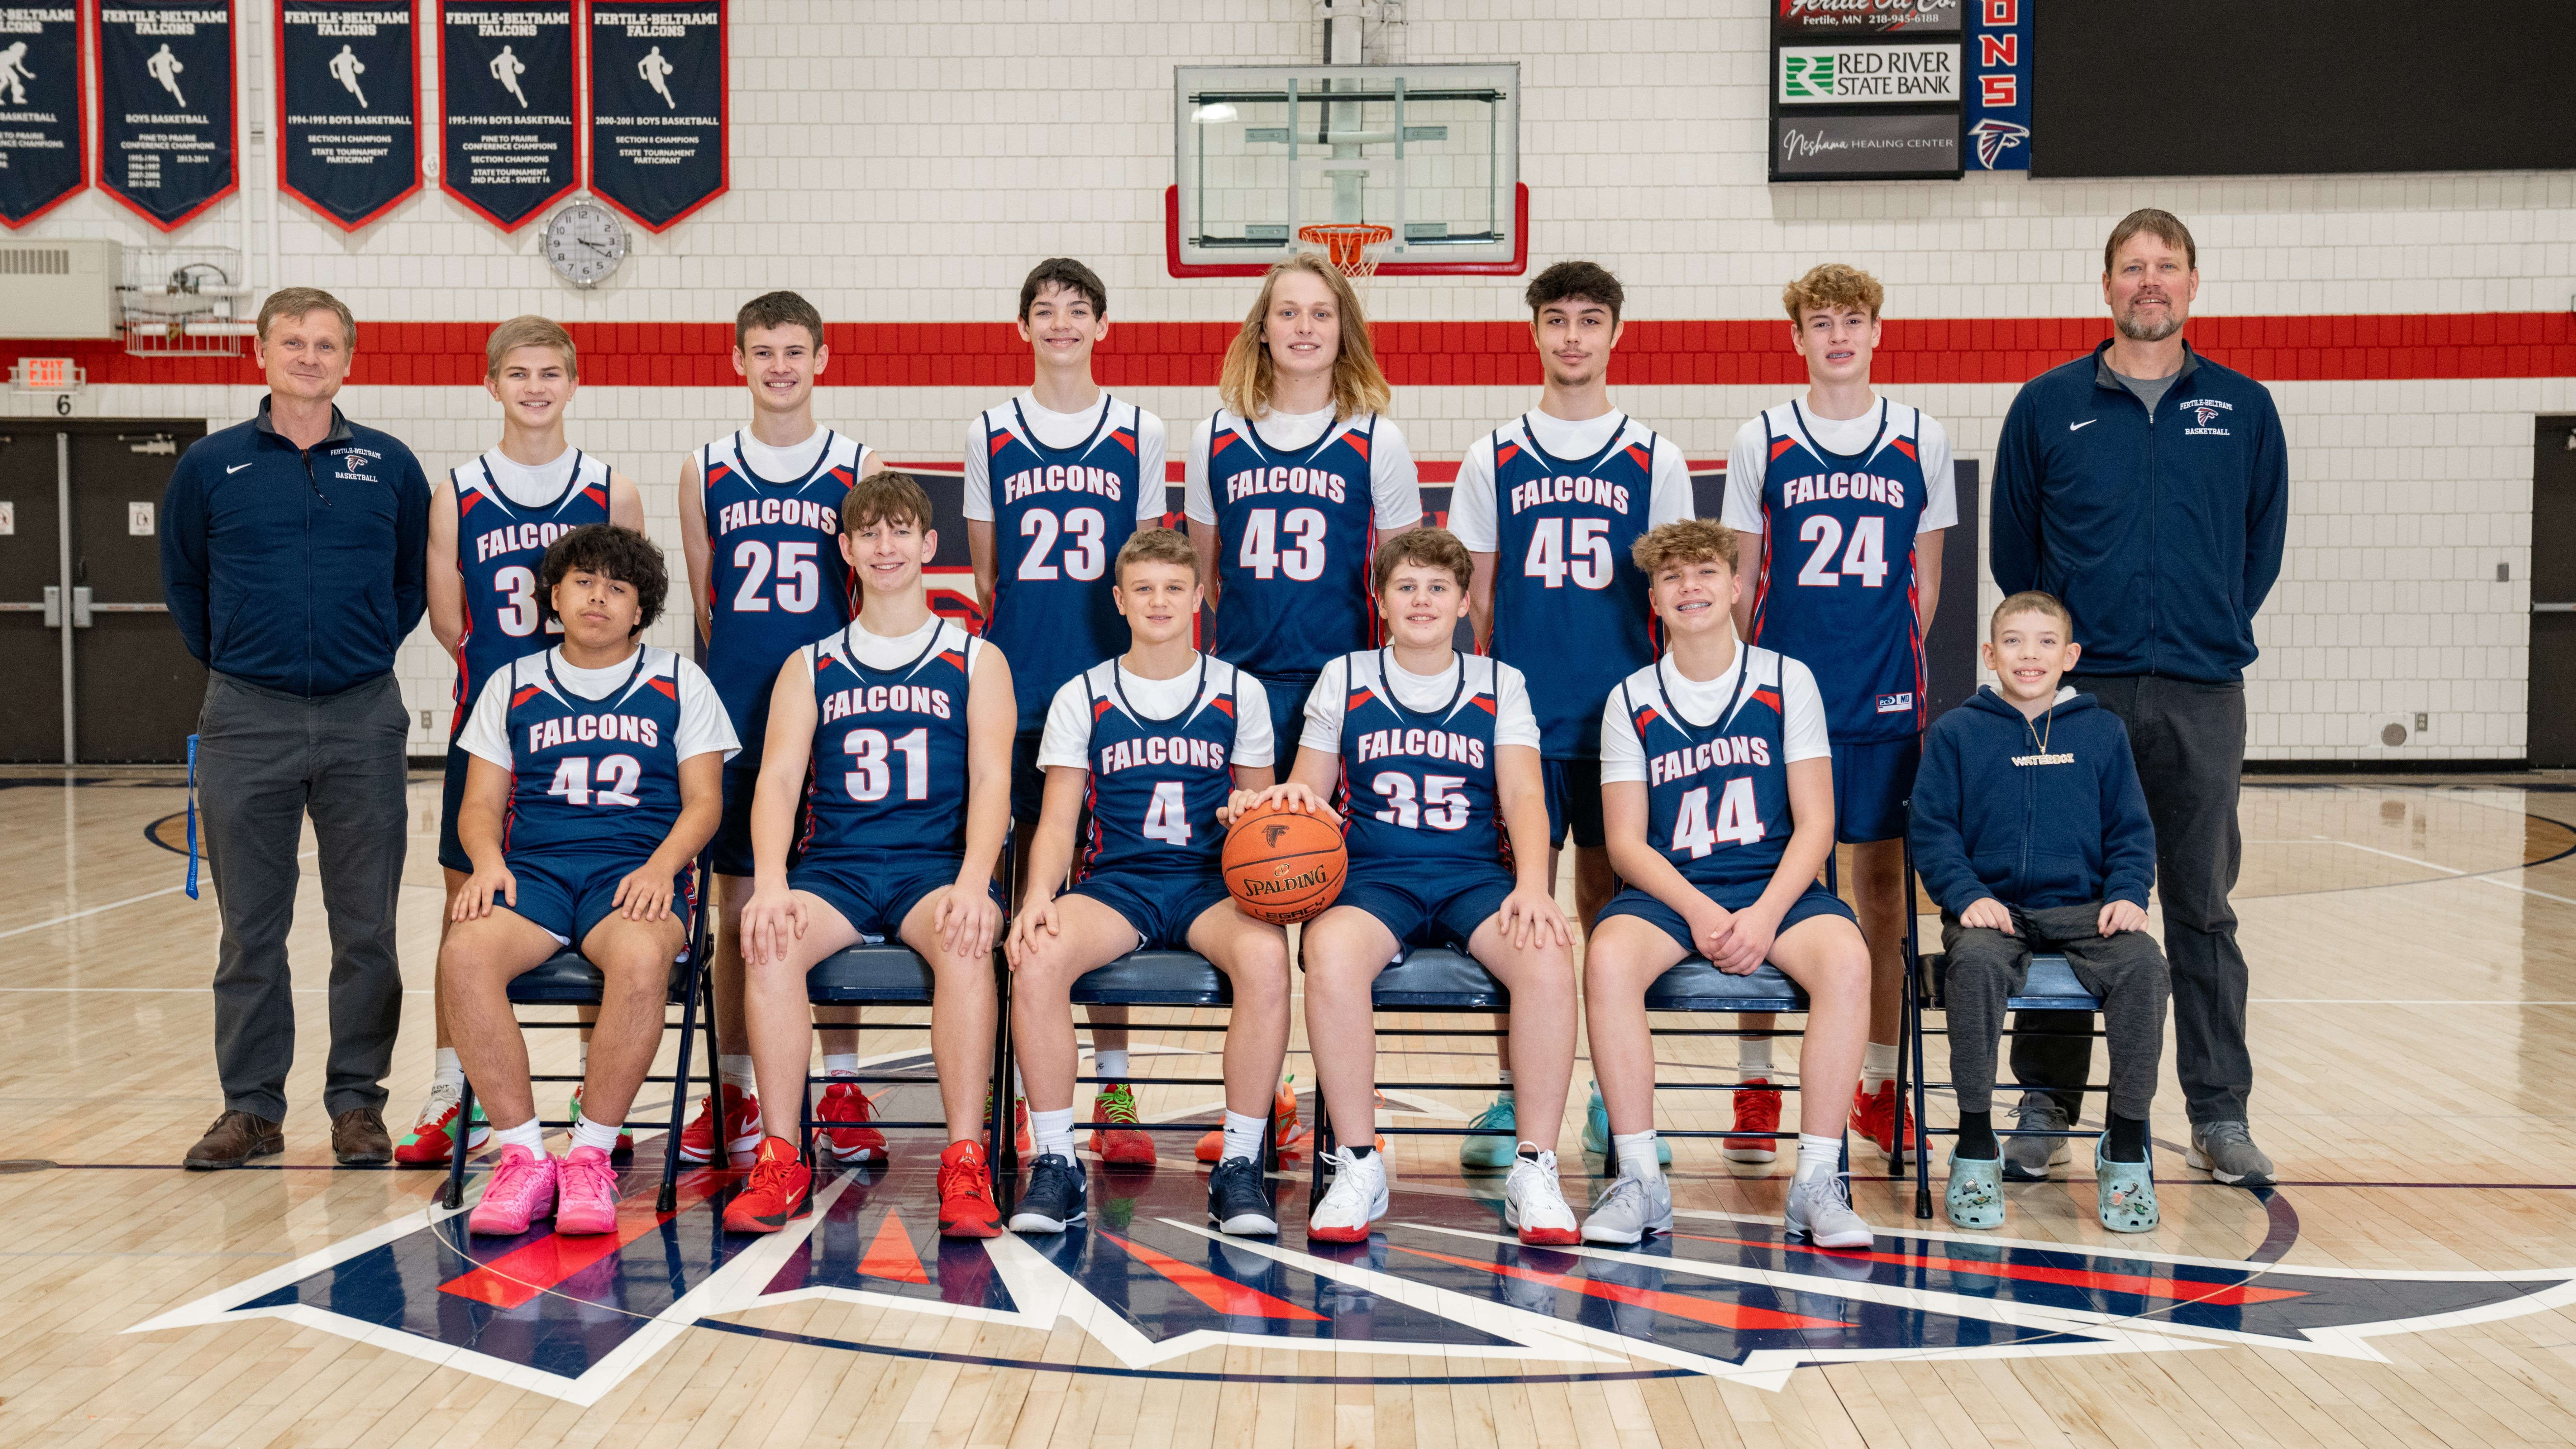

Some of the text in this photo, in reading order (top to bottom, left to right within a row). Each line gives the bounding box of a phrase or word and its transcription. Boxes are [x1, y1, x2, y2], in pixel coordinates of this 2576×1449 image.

[102, 10, 227, 23] FERTILE-BELTRAMI
[285, 11, 409, 24] FERTILE-BELTRAMI
[445, 12, 569, 24] FERTILE-BELTRAMI
[594, 13, 717, 25] FERTILE-BELTRAMI
[1803, 14, 1939, 26] Fertile, MN 218-945-6188
[135, 23, 195, 35] FALCONS
[318, 24, 377, 36] FALCONS
[479, 25, 537, 36] FALCONS
[626, 25, 685, 37] FALCONS
[1839, 52, 1951, 74] RED RIVER
[1838, 75, 1951, 96] STATE BANK
[125, 114, 209, 124] BOYS BASKETBALL
[288, 115, 412, 125] 1994-1995 BOYS BASKETBALL
[448, 116, 572, 125] 1995-1996 BOYS BASKETBALL
[595, 116, 719, 125] 2000-2001 BOYS BASKETBALL
[120, 141, 170, 149] CONFERENCE
[347, 135, 392, 143] CHAMPIONS
[1783, 129, 1953, 161] Neshama HEALING CENTER
[578, 211, 587, 219] 12
[557, 226, 565, 235] 10
[568, 263, 574, 274] 7
[57, 395, 71, 415] 6
[2180, 399, 2233, 411] FERTILE-BELTRAMI
[330, 447, 381, 460] FERTILE-BELTRAMI
[335, 472, 378, 482] BASKETBALL
[1004, 465, 1121, 505] FALCONS
[1227, 466, 1346, 504] FALCONS
[1511, 475, 1629, 515] FALCONS
[1783, 472, 1905, 509] FALCONS
[720, 498, 837, 536] FALCONS
[477, 522, 576, 564] FALCO
[1017, 507, 1106, 581] 23
[1240, 507, 1327, 582] 43
[1525, 517, 1614, 590] 45
[1798, 514, 1888, 588] 24
[733, 540, 819, 613] 25
[494, 565, 564, 637] 3
[824, 685, 951, 725] FALCONS
[1900, 695, 1909, 703] MD
[529, 714, 659, 754] FALCONS
[1101, 736, 1225, 775] FALCONS
[1358, 728, 1484, 769] FALCONS
[2011, 753, 2075, 766] WATERBOI
[843, 727, 929, 801] 31
[1650, 736, 1771, 788] FALCONS
[547, 754, 642, 807] 42
[1372, 771, 1471, 830] 35
[1143, 781, 1192, 846] 4
[1671, 776, 1766, 860] 44
[1243, 864, 1327, 896] SPALDING
[1255, 897, 1325, 919] LEGACY
